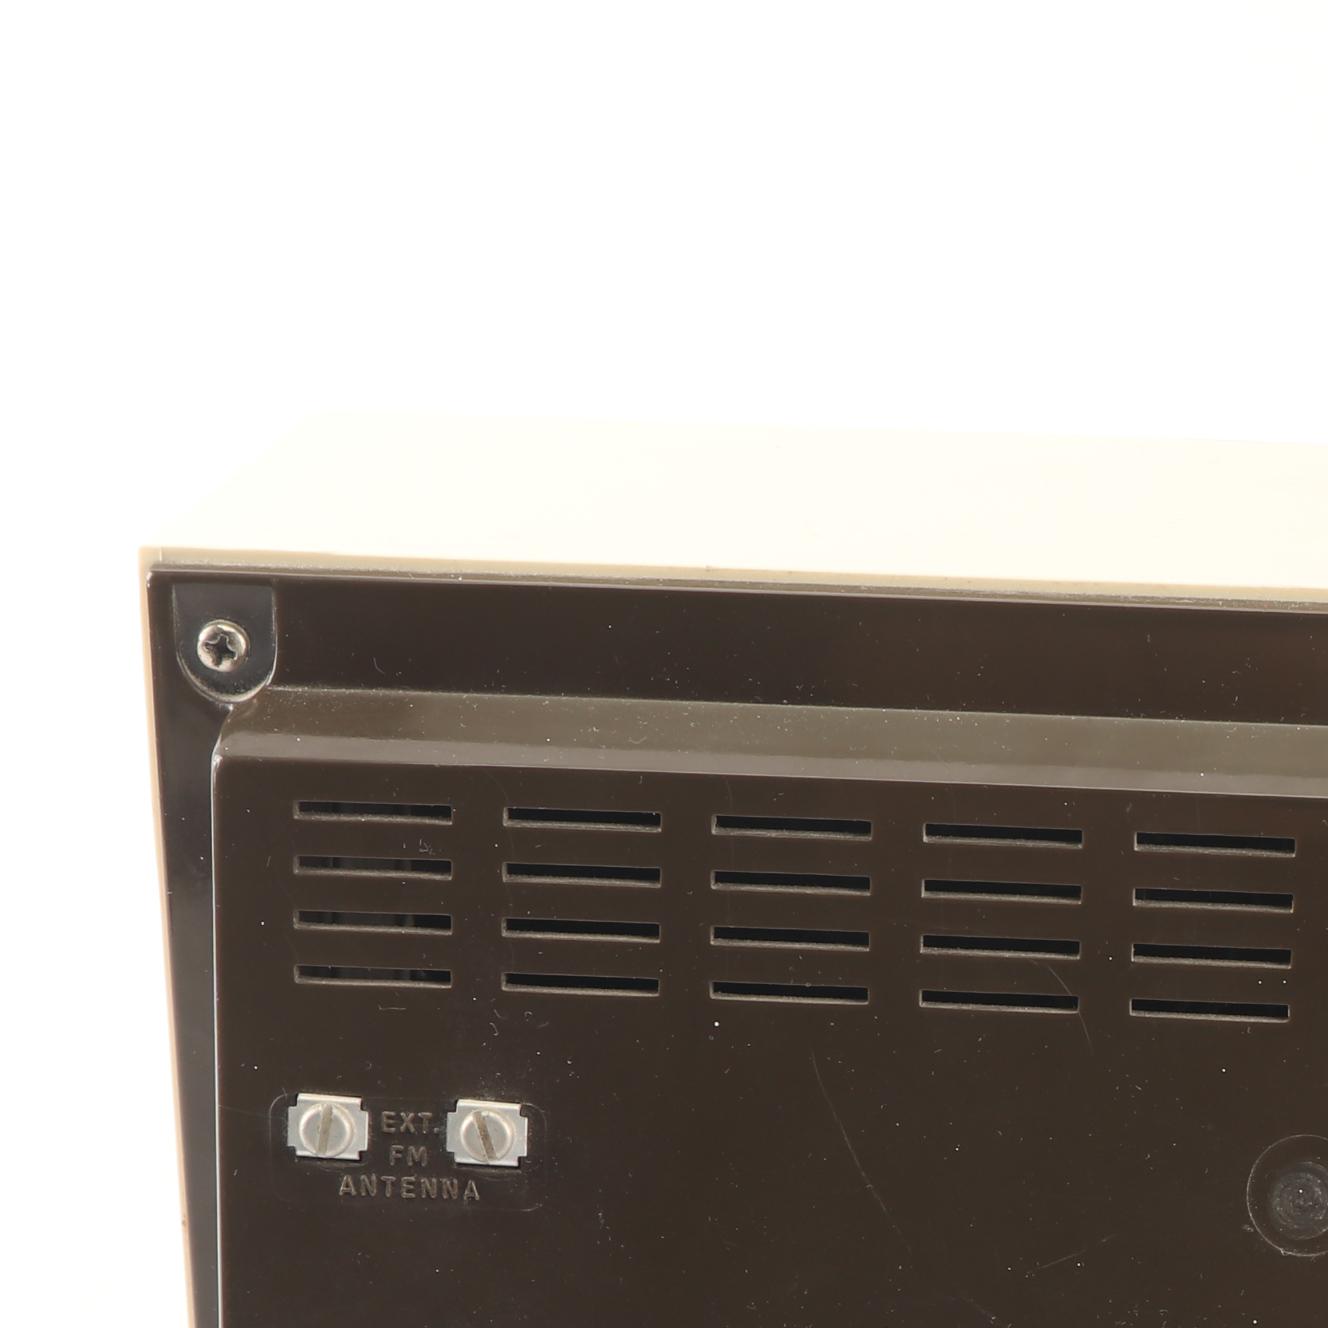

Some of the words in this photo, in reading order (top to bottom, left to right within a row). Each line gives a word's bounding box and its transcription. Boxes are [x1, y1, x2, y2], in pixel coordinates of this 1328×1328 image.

[380, 1110, 440, 1135] EXT.
[388, 1144, 428, 1168] FM
[337, 1173, 481, 1201] ANTENNA
